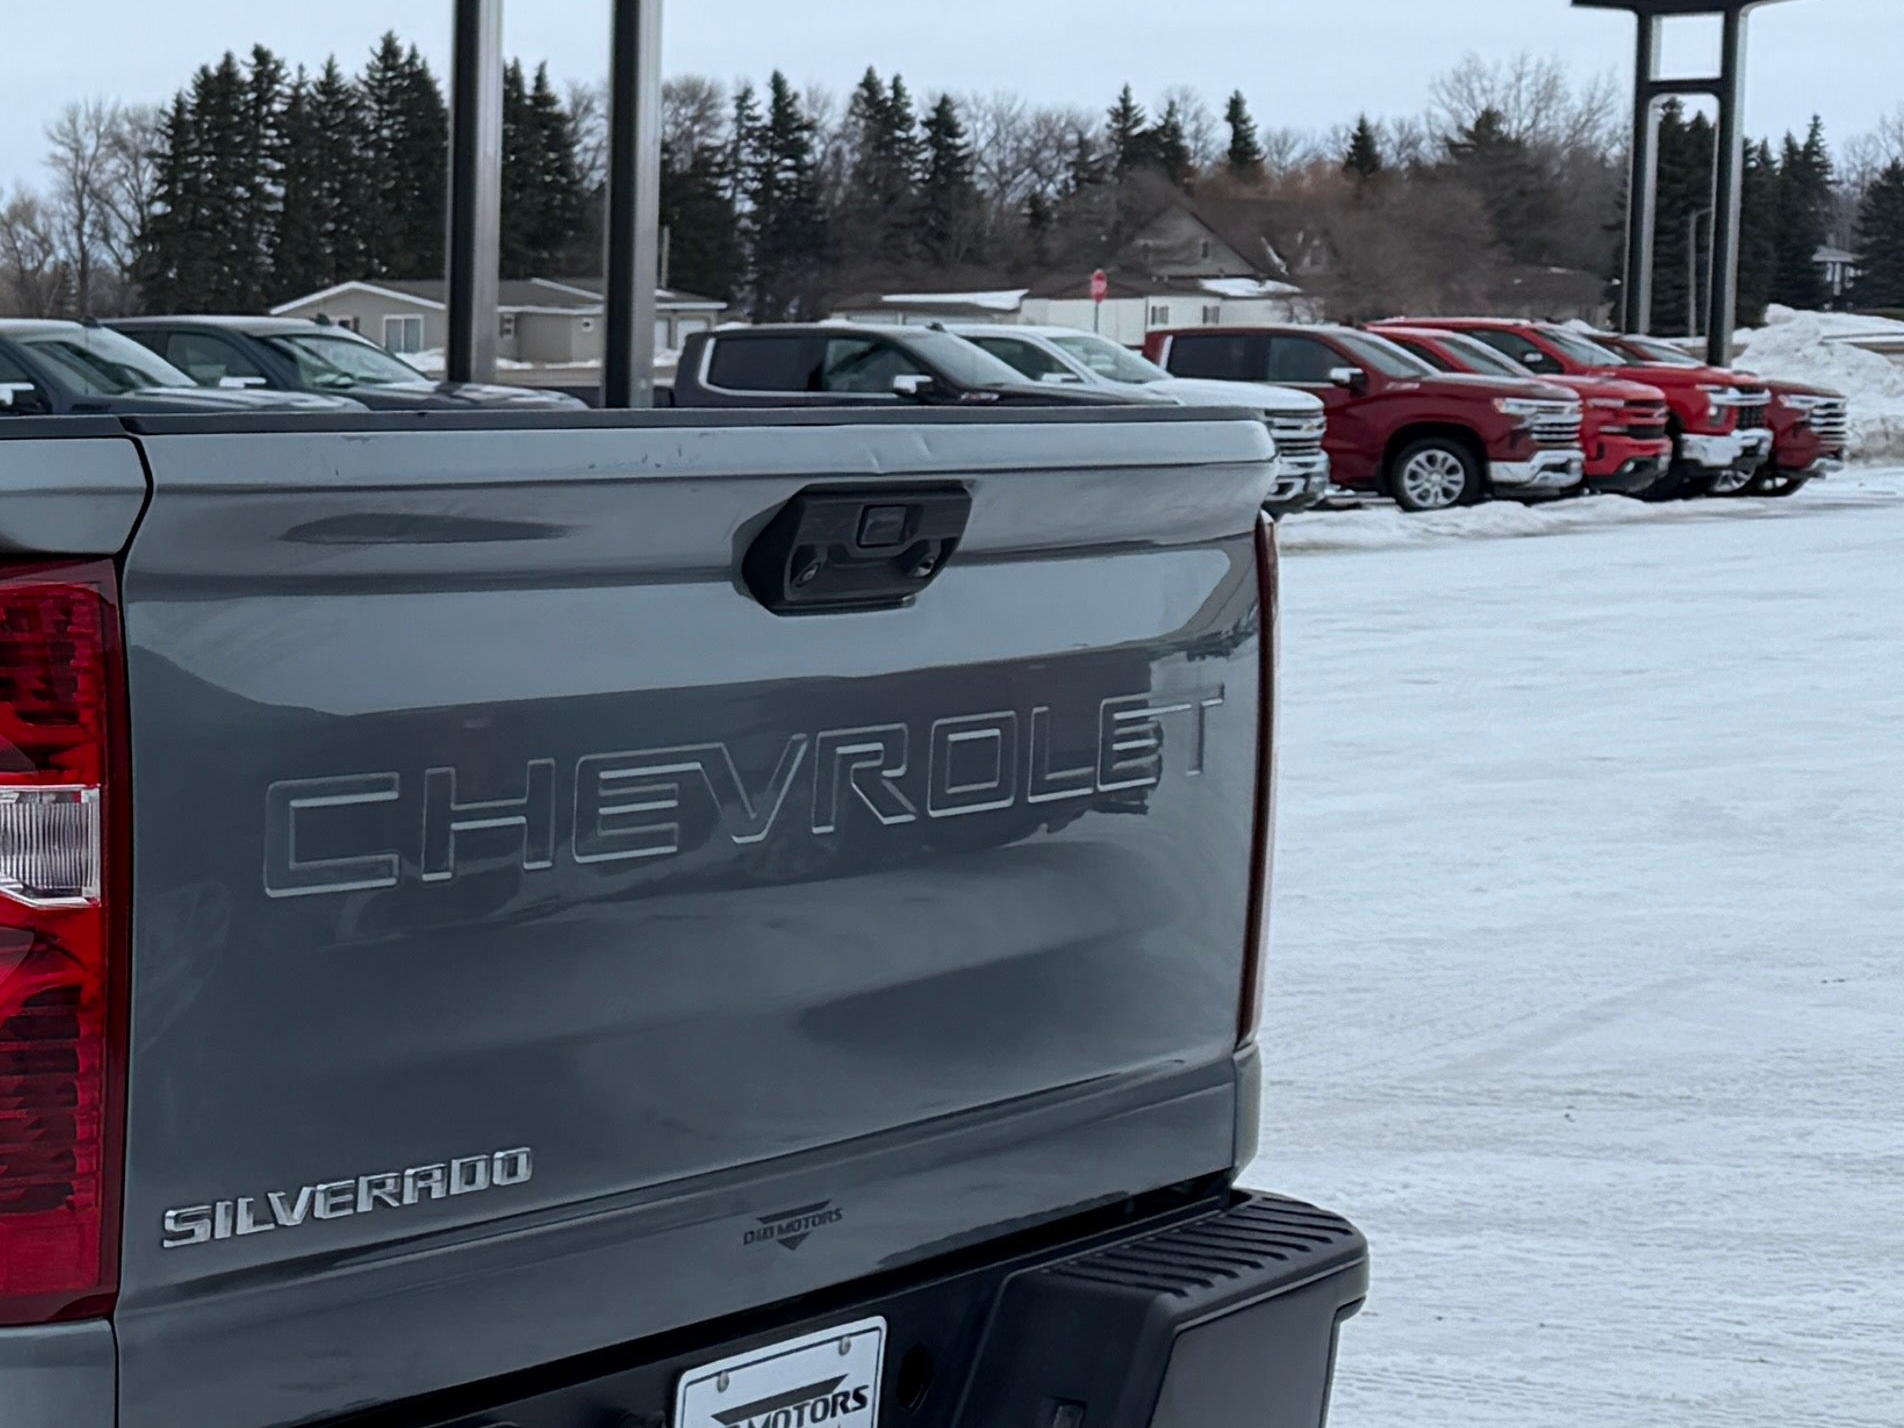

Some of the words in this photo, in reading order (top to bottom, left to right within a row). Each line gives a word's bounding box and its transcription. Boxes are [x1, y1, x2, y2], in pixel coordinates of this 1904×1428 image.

[261, 682, 1226, 899] CHEVROLET
[161, 1145, 534, 1249] SILVERADO
[776, 1207, 843, 1235] MOTORS
